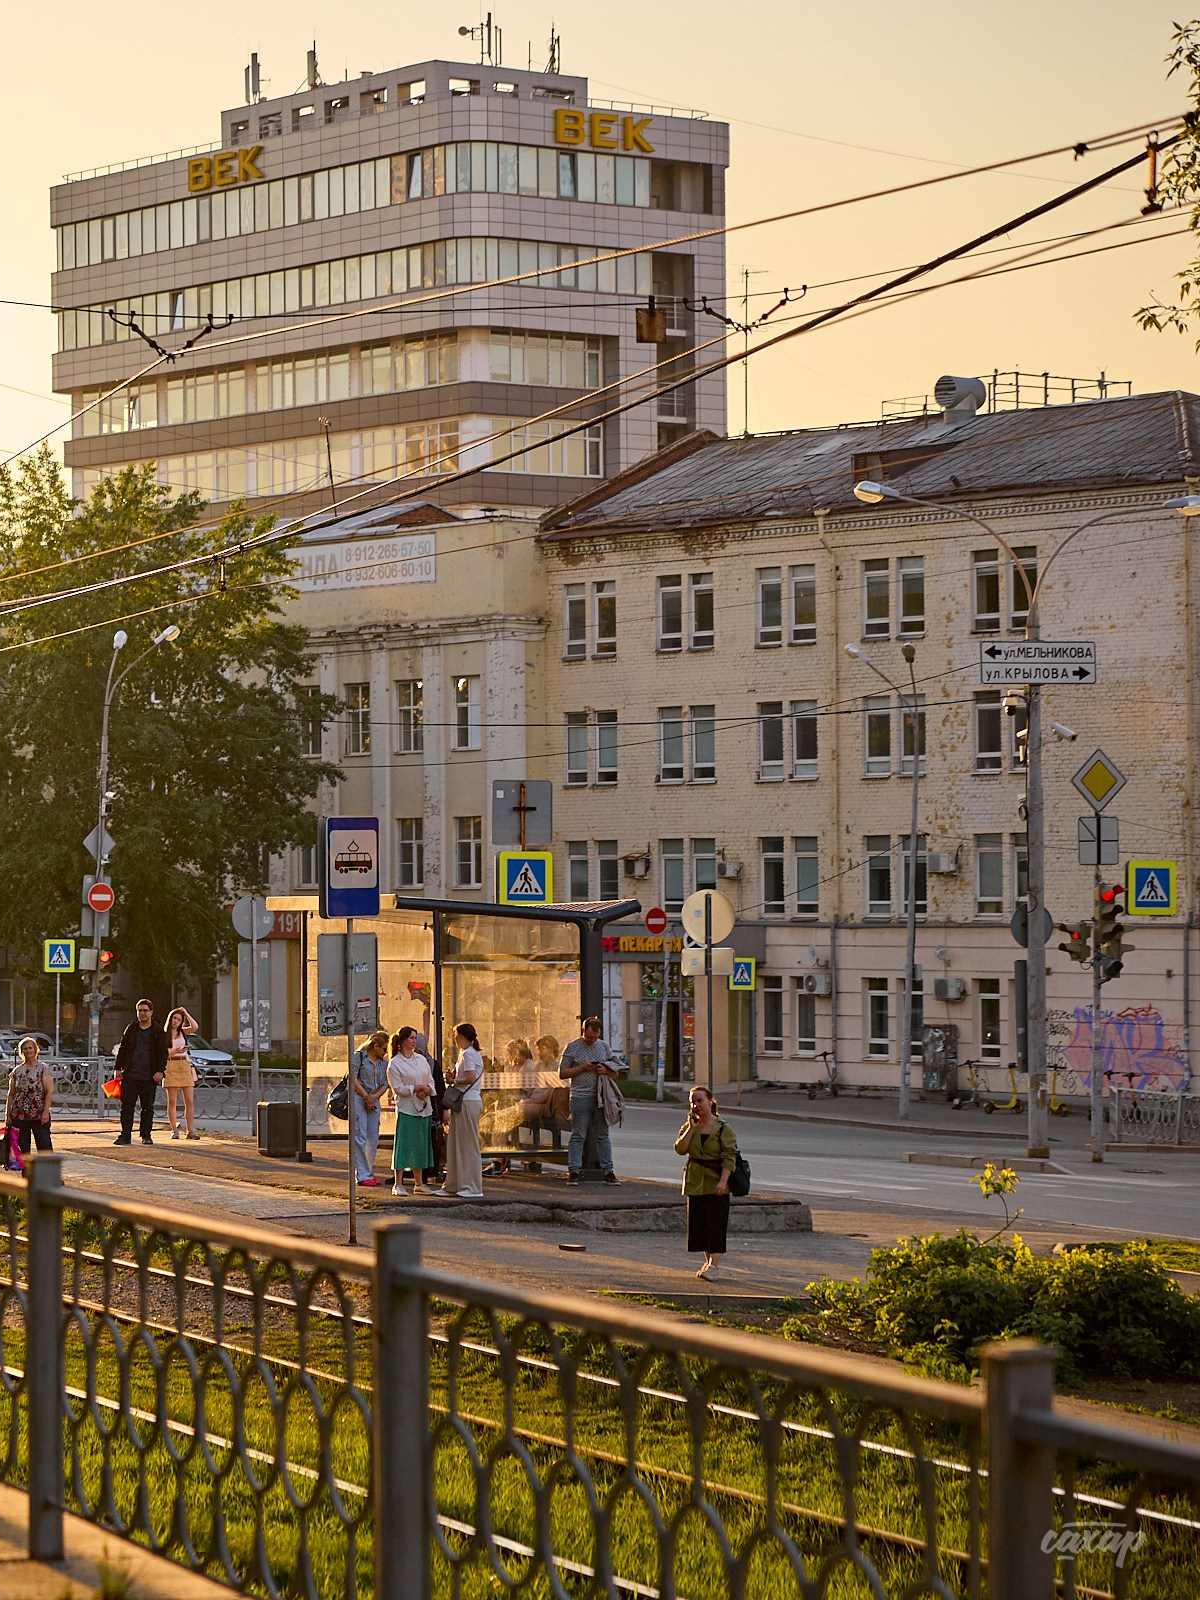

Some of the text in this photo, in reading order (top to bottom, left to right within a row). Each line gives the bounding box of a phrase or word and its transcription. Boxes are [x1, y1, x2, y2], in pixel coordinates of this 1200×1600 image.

[554, 108, 655, 153] ВЕК
[187, 145, 264, 192] ВЕК
[290, 553, 340, 586] НДА
